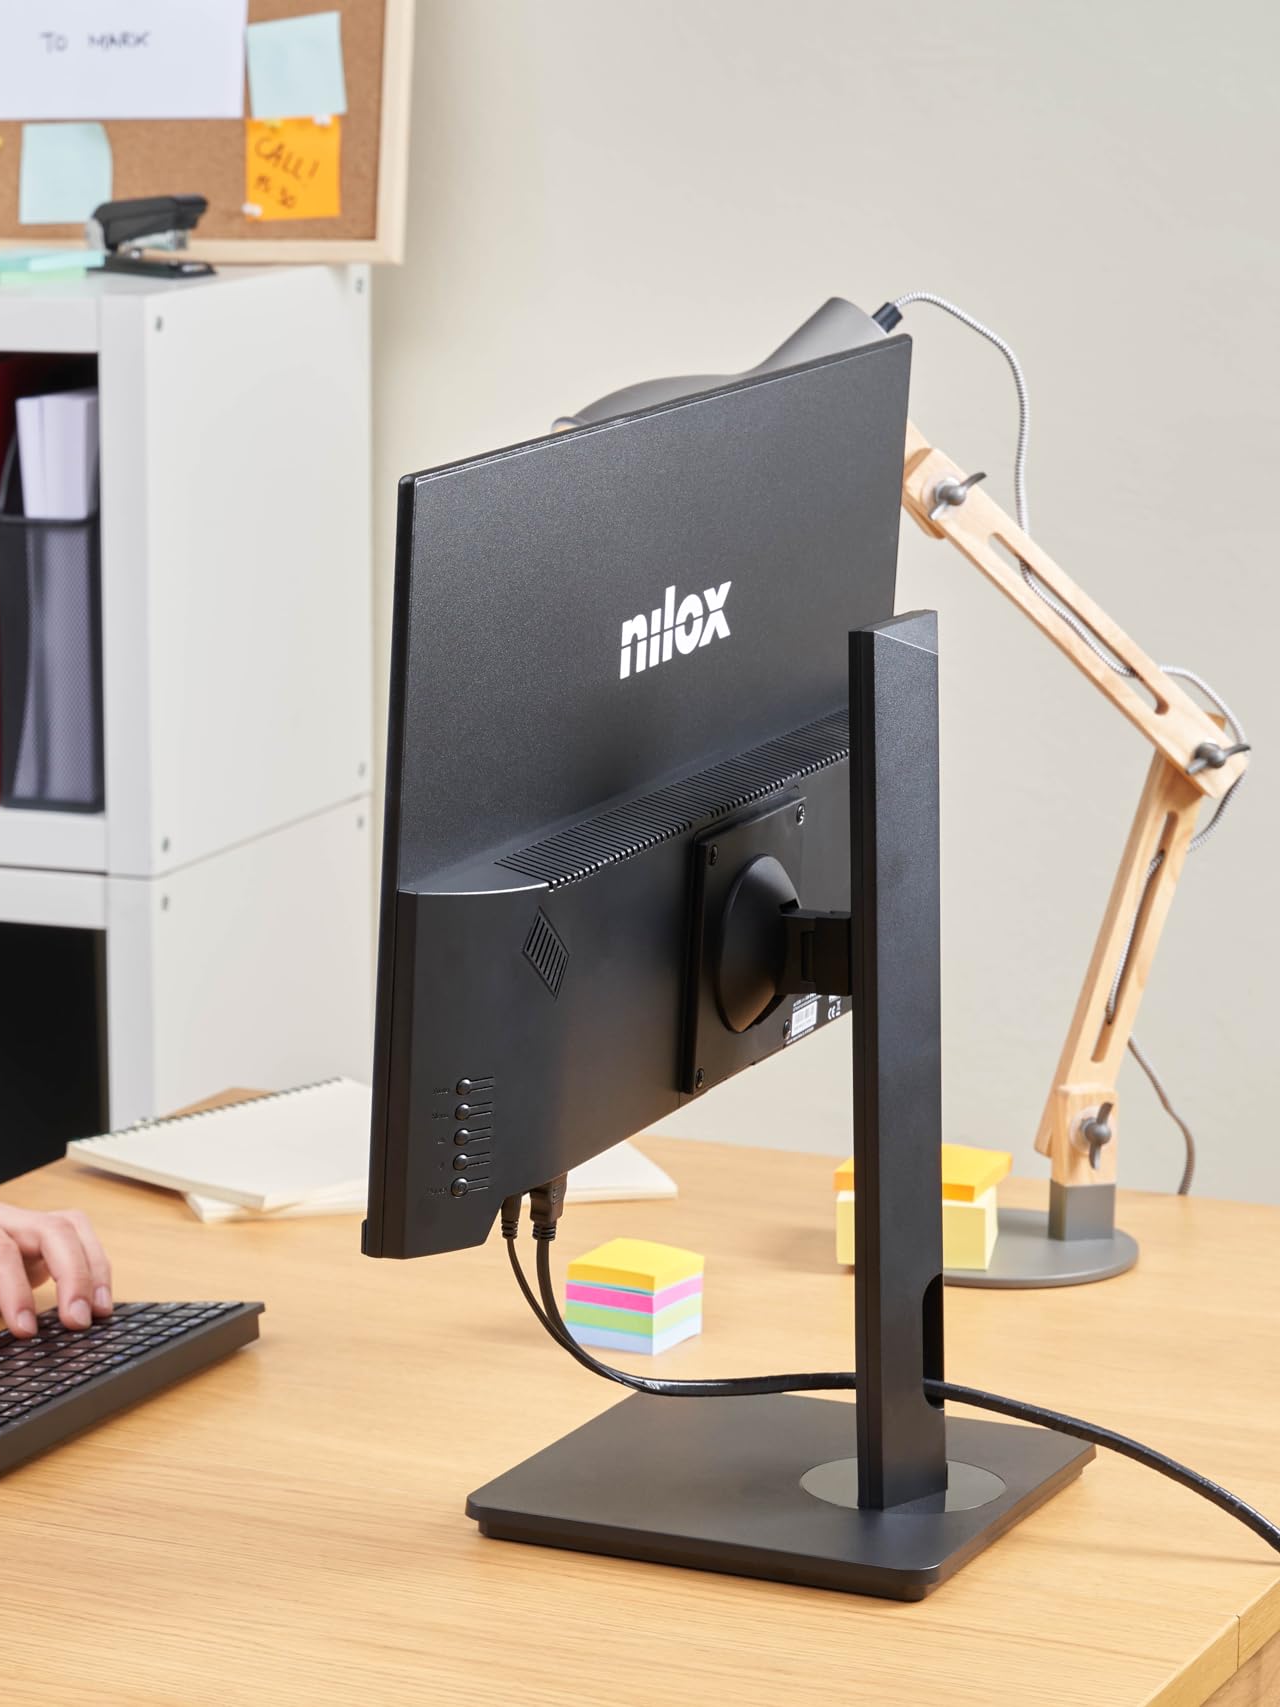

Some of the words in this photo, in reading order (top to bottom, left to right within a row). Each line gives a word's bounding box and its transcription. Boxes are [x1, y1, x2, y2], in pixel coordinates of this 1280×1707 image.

[40, 31, 68, 52] TO
[88, 31, 150, 50] MARK
[255, 137, 320, 180] CALL!
[620, 581, 732, 680] nilox
